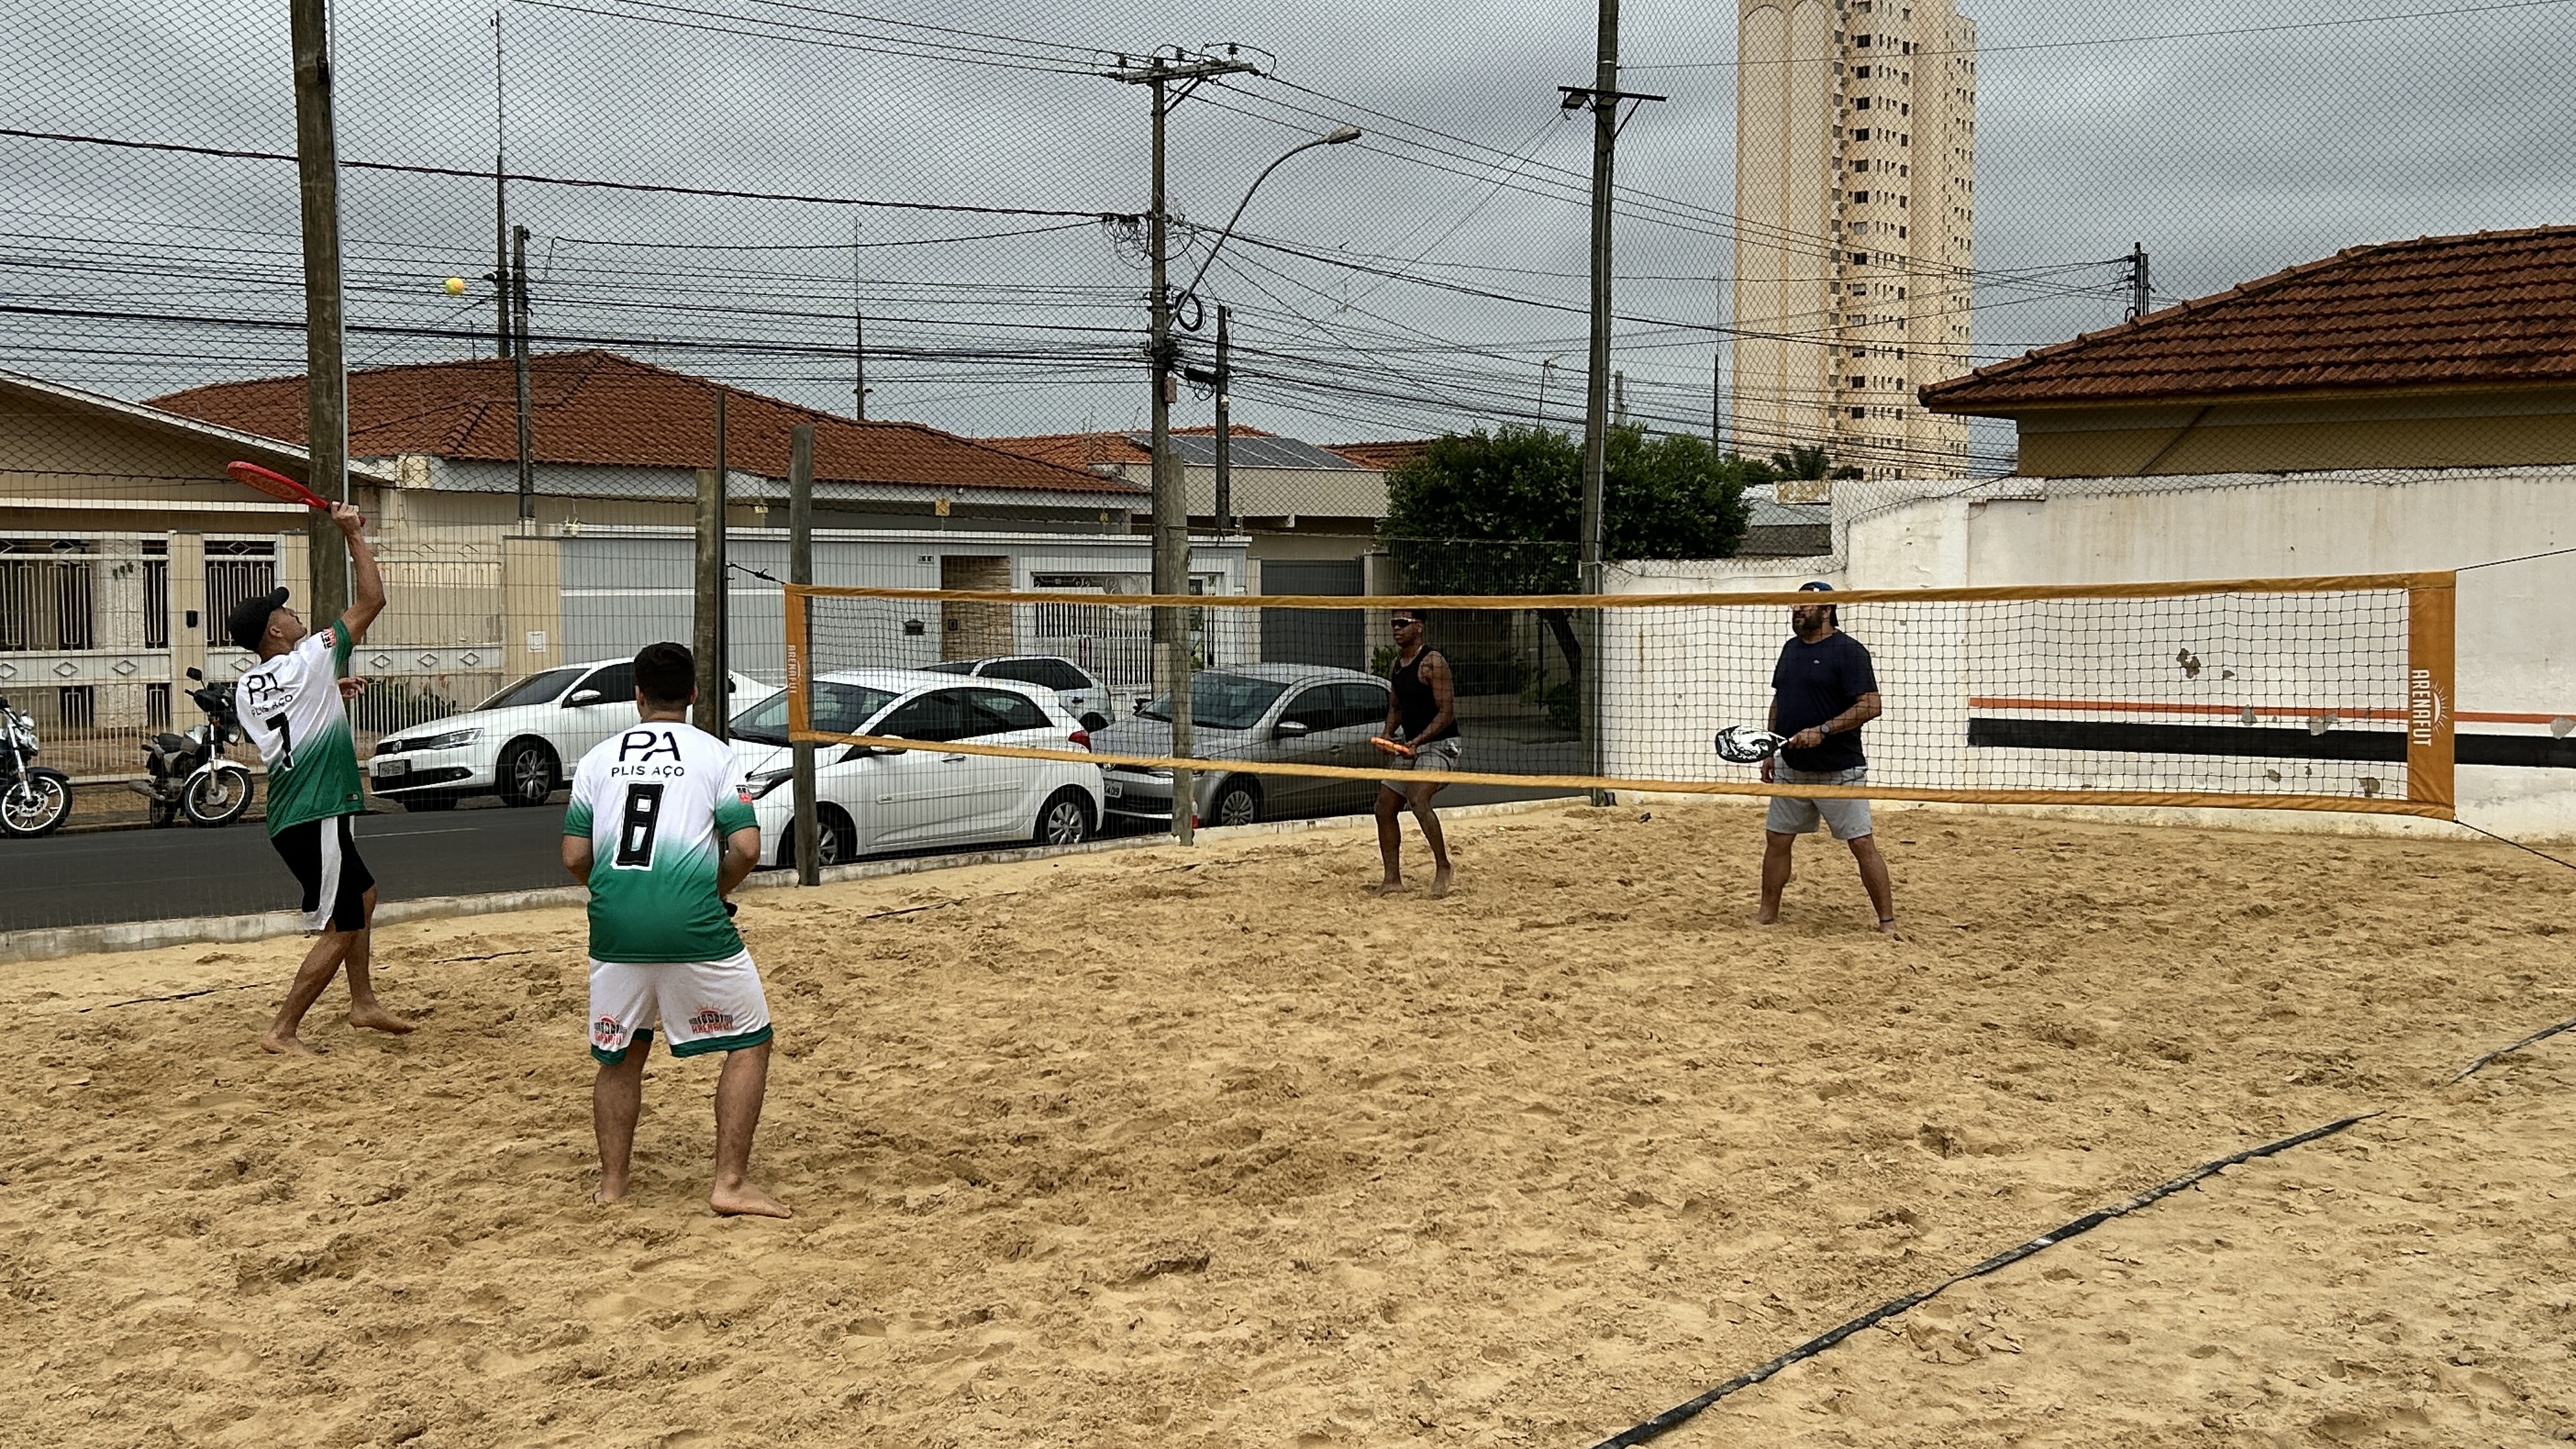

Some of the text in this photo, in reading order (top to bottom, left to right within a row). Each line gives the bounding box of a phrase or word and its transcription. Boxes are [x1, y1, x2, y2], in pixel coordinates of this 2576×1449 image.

[2412, 669, 2432, 747] ARENAFUT
[265, 712, 293, 769] 7
[618, 730, 681, 762] PA
[611, 765, 685, 778] PLIS AÇO
[615, 782, 664, 867] 8
